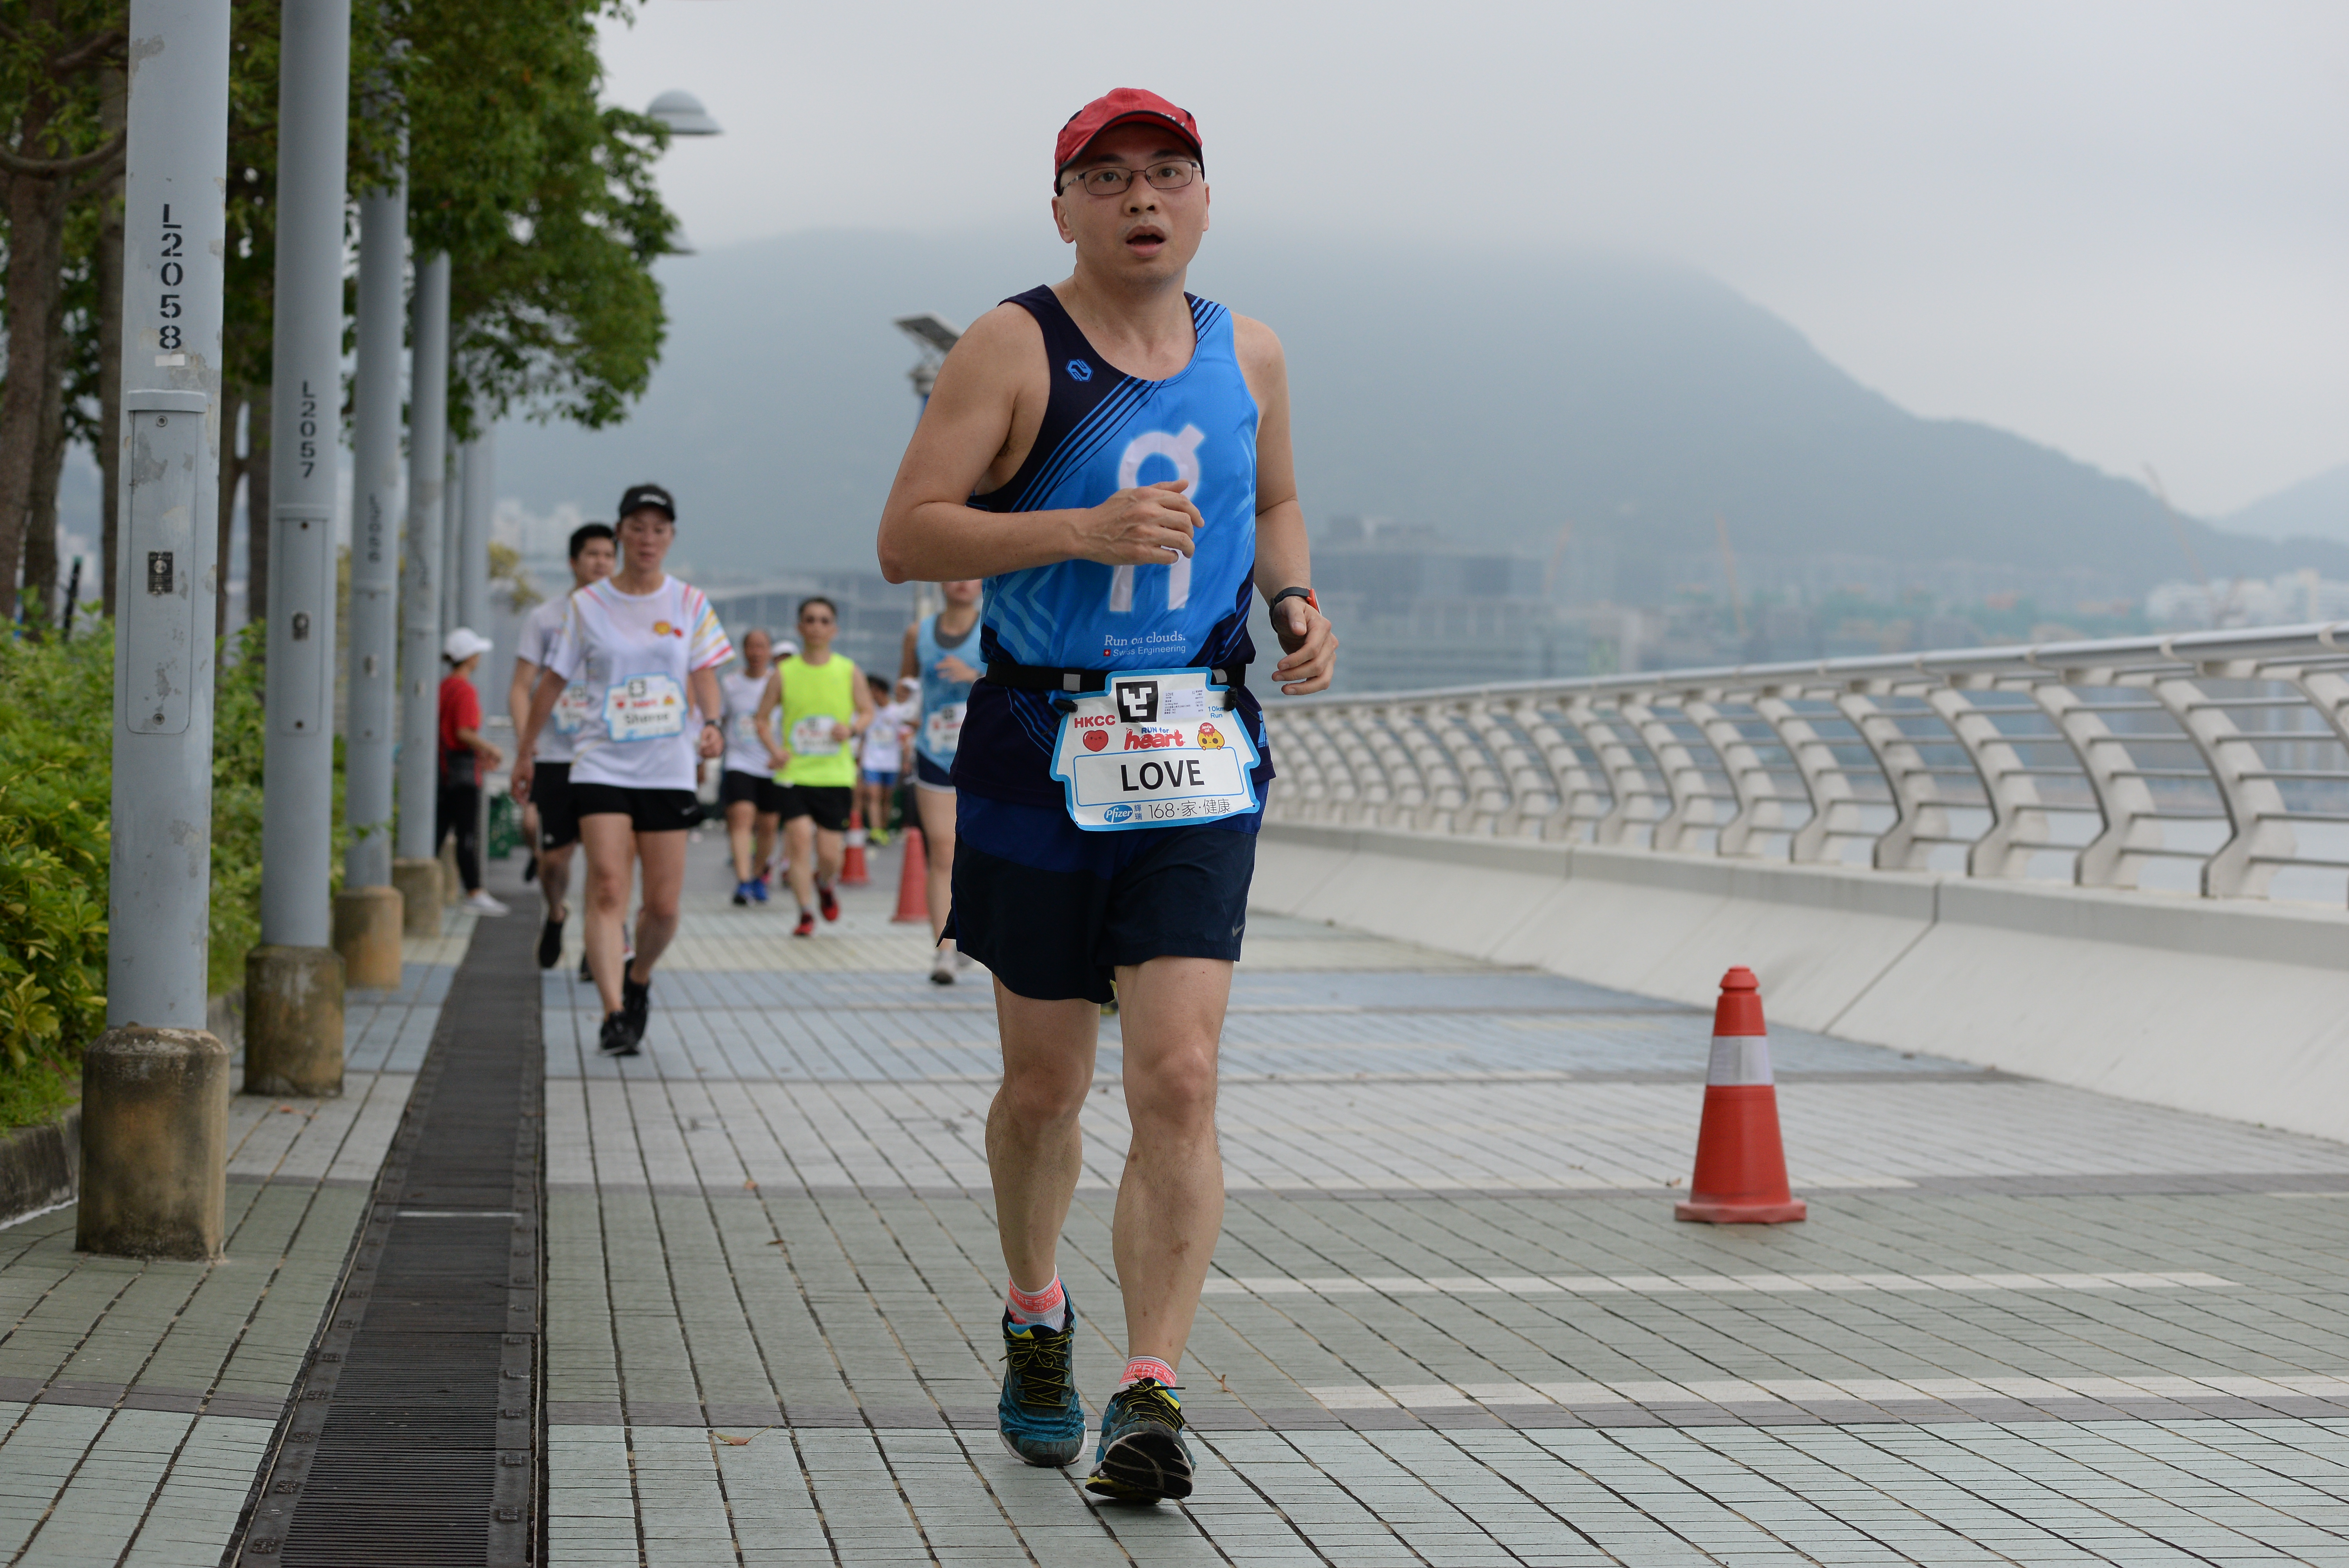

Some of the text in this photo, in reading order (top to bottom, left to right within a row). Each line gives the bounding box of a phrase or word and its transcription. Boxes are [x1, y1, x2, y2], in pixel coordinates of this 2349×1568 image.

[159, 204, 183, 349] L2058
[301, 380, 315, 478] L2057
[1104, 635, 1128, 646] Run
[1146, 631, 1185, 643] clouds.
[1138, 645, 1185, 655] Engineering
[1075, 715, 1116, 728] HKCC
[1124, 729, 1184, 750] heart
[1121, 760, 1205, 791] LOVE
[1106, 807, 1132, 823] Pfizer
